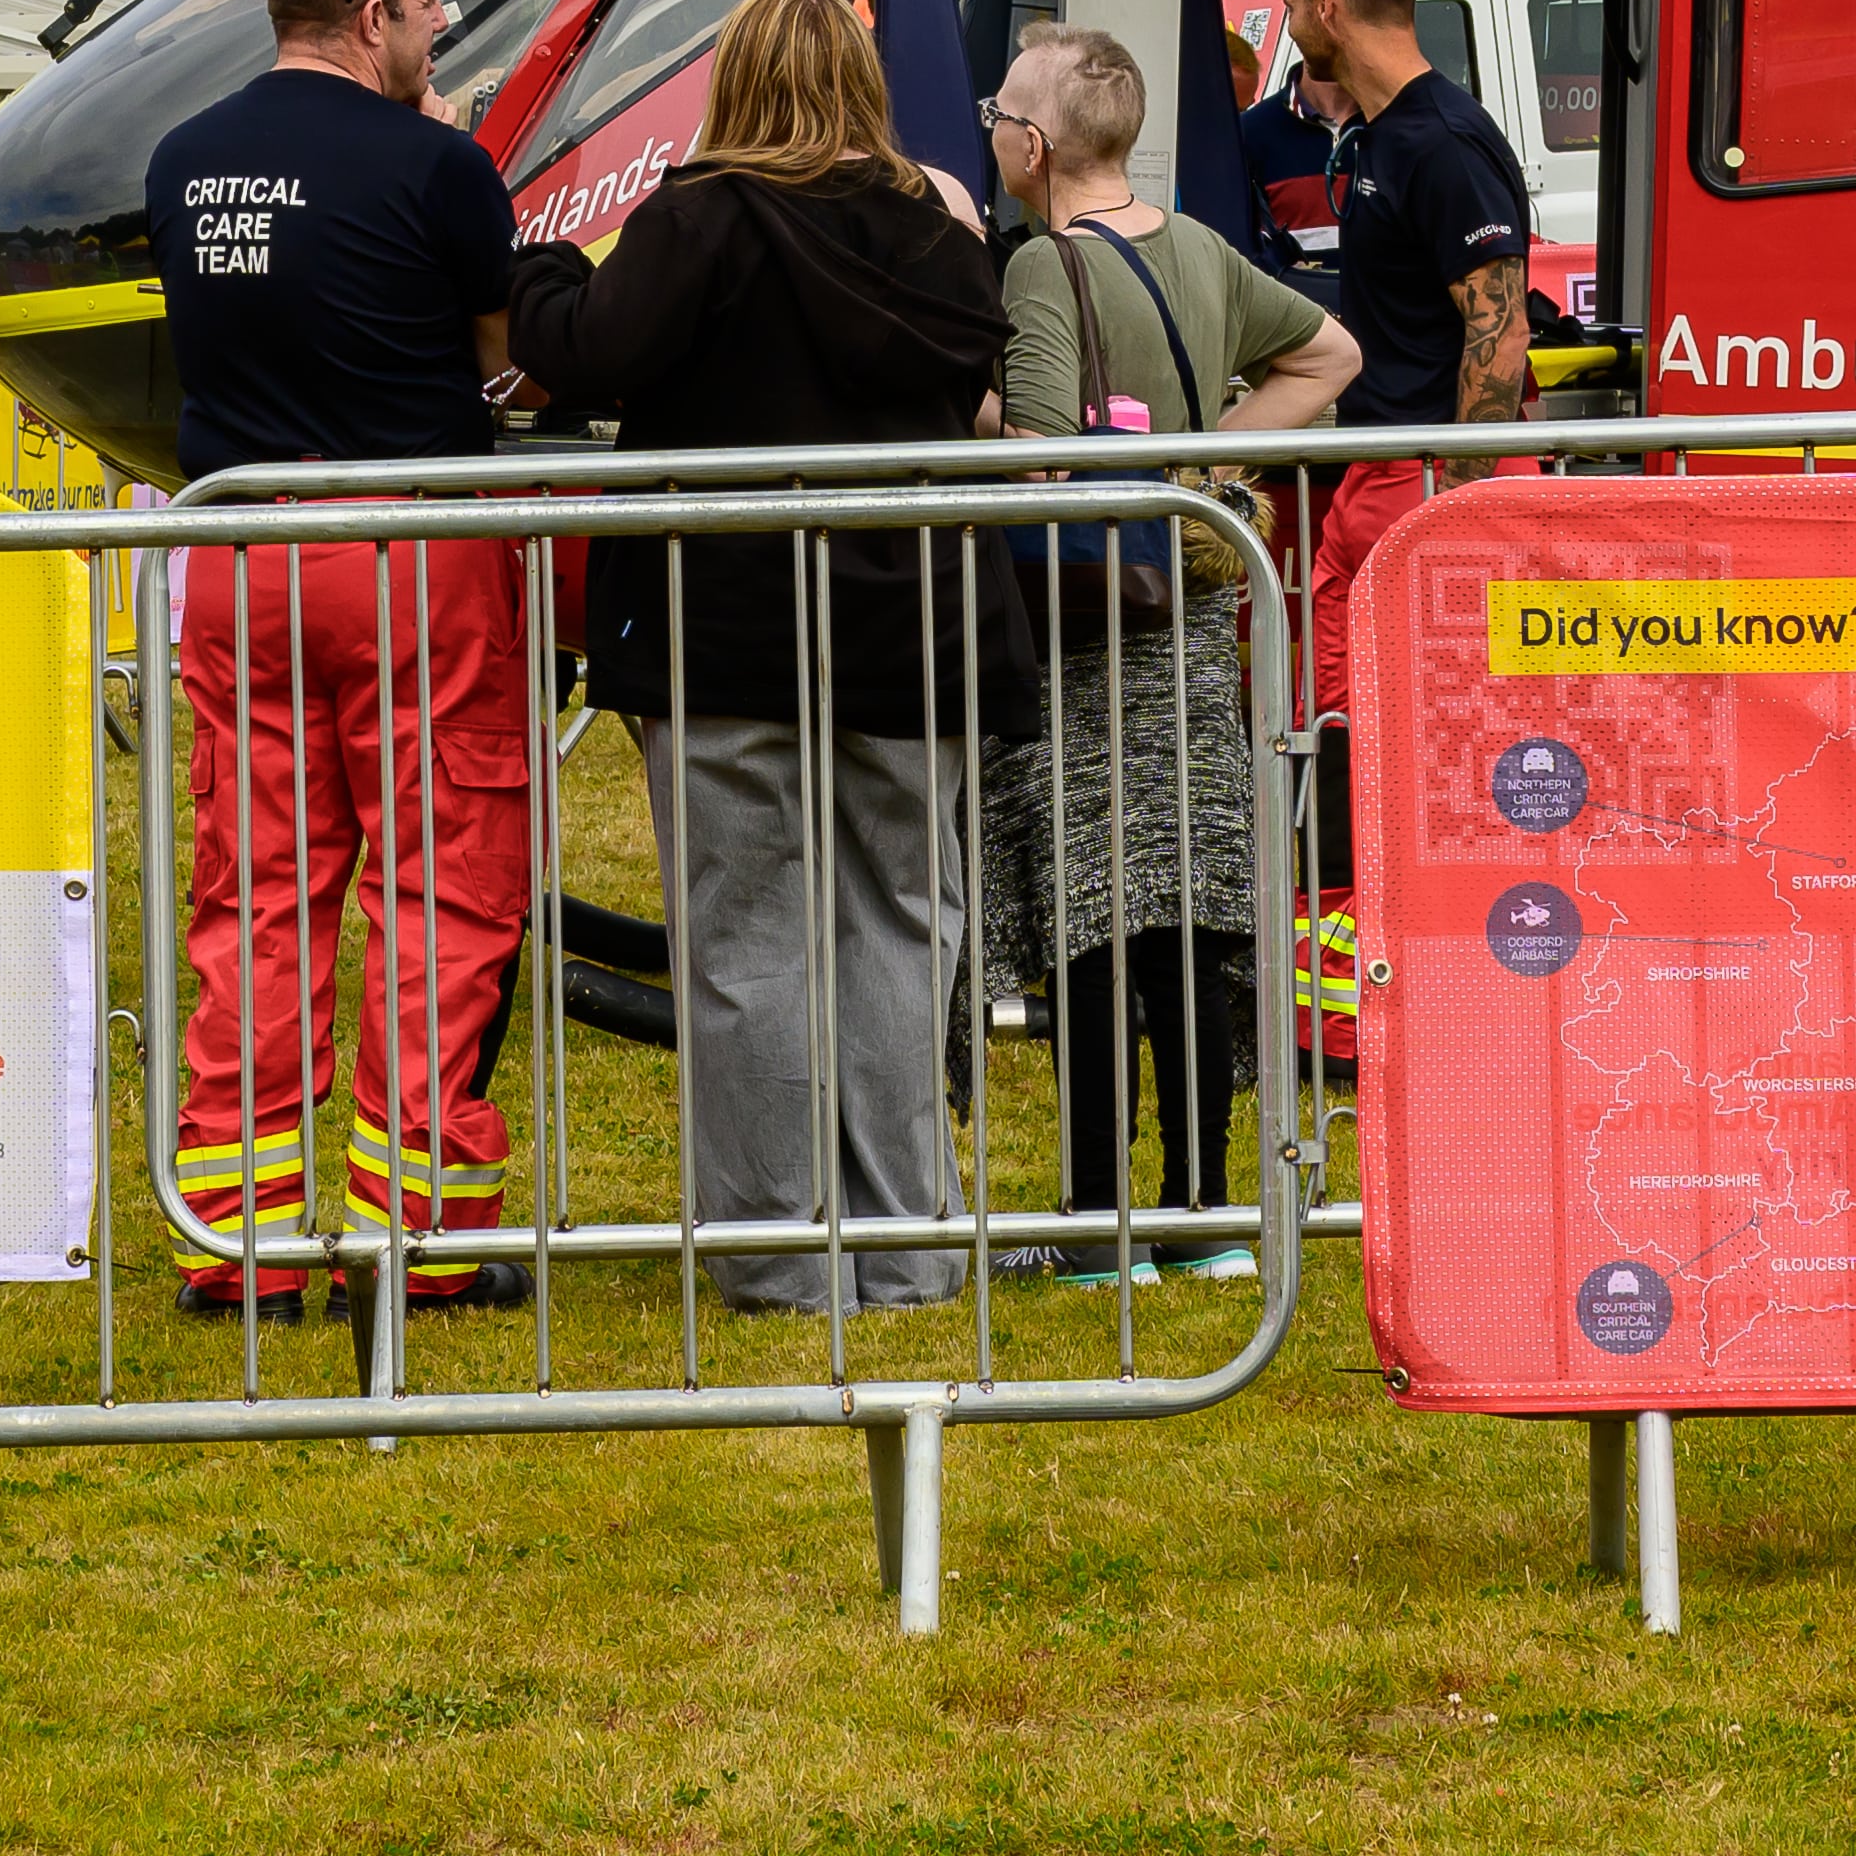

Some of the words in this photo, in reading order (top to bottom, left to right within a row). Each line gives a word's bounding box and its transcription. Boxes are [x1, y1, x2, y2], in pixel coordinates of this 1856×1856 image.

[185, 177, 306, 207] CRITICAL
[196, 213, 273, 240] CARE
[195, 246, 269, 274] TEAM
[1519, 607, 1601, 648] Did
[1611, 613, 1703, 658] you
[1507, 778, 1572, 792] NORTHERN
[1513, 793, 1567, 805] CRITICAL
[1510, 807, 1541, 820] CARE
[1544, 807, 1570, 819] CAR
[1507, 936, 1563, 948] COSFORD
[1511, 949, 1560, 961] AIRBASE
[1647, 966, 1751, 982] SHROPSHIRE
[1629, 1173, 1763, 1189] HEREFORDSHIRE
[1592, 1301, 1656, 1314] SOUTHERN
[1597, 1315, 1651, 1328] CRITICAL
[1596, 1329, 1628, 1342] CARE
